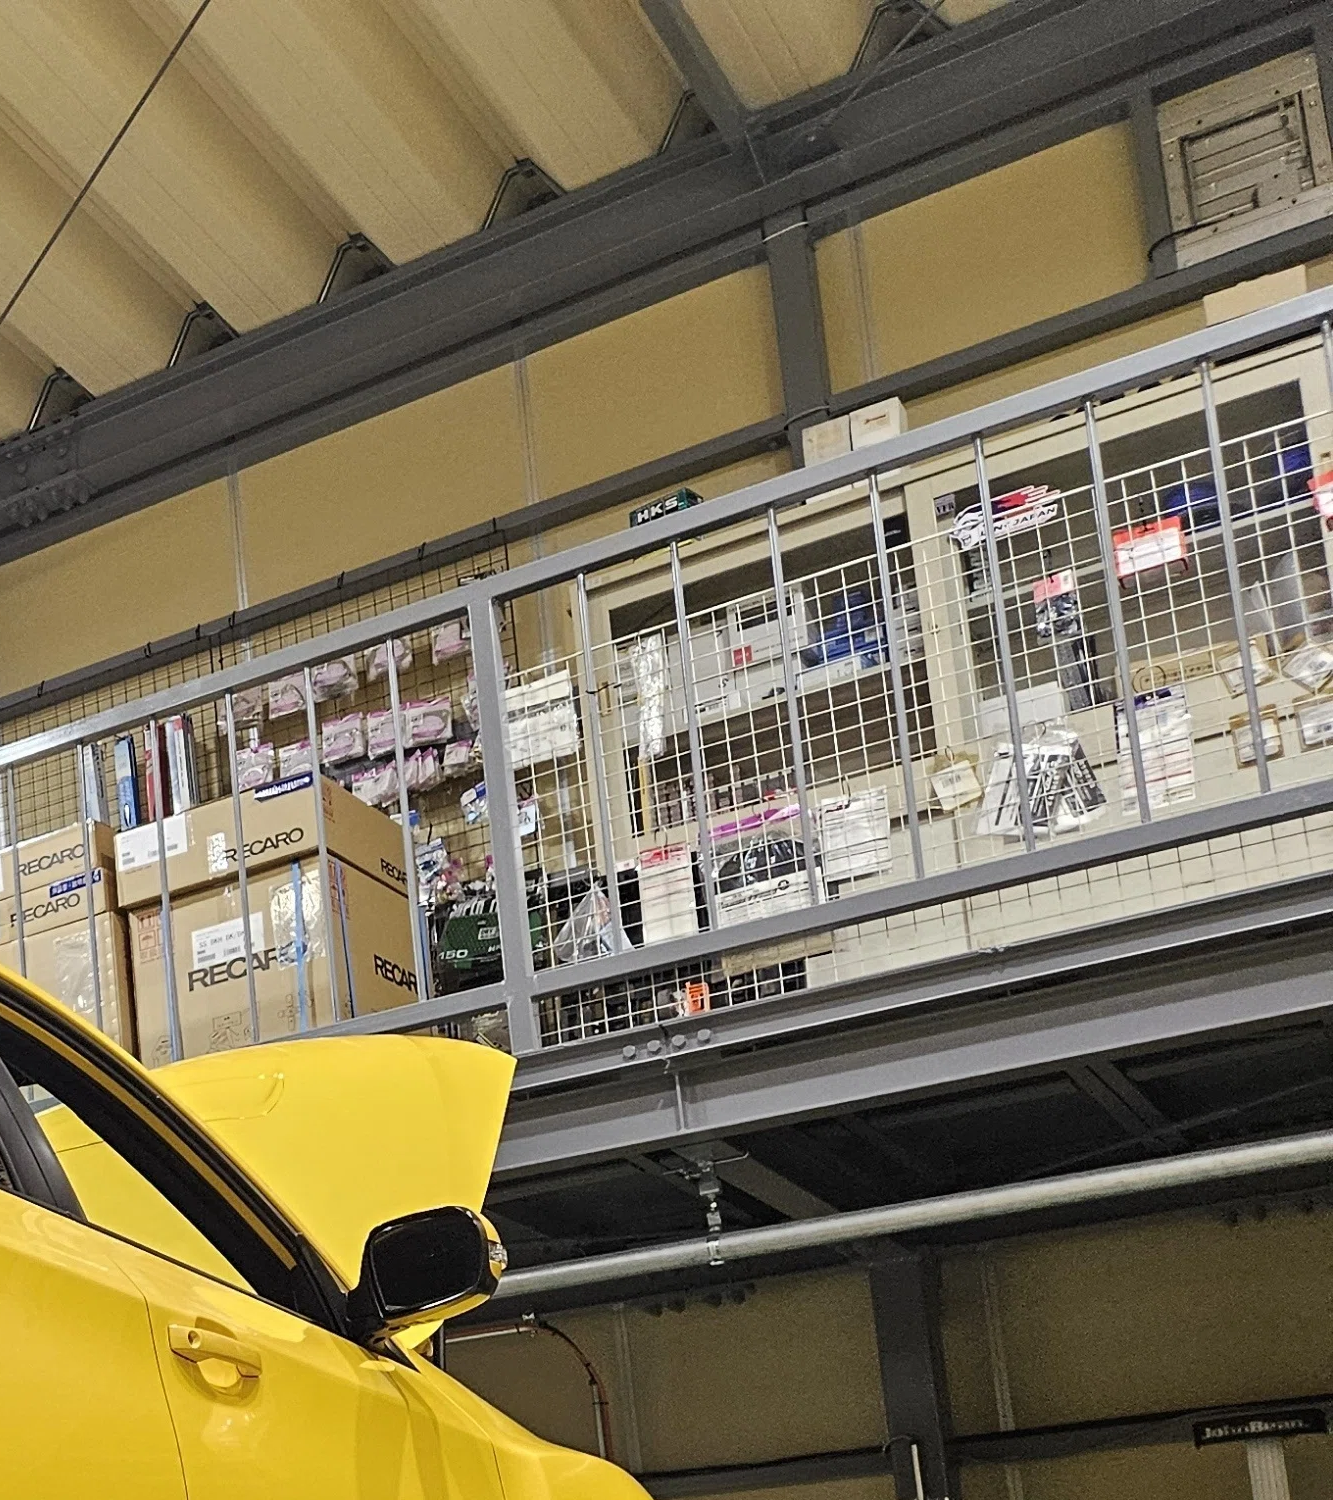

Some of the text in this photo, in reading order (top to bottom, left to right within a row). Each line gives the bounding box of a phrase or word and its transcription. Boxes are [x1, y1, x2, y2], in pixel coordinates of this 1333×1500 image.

[637, 496, 678, 523] HKS
[17, 843, 86, 877] RECARO
[224, 827, 305, 863] RECARO
[379, 857, 409, 886] RECAR
[373, 953, 419, 995] RECAR
